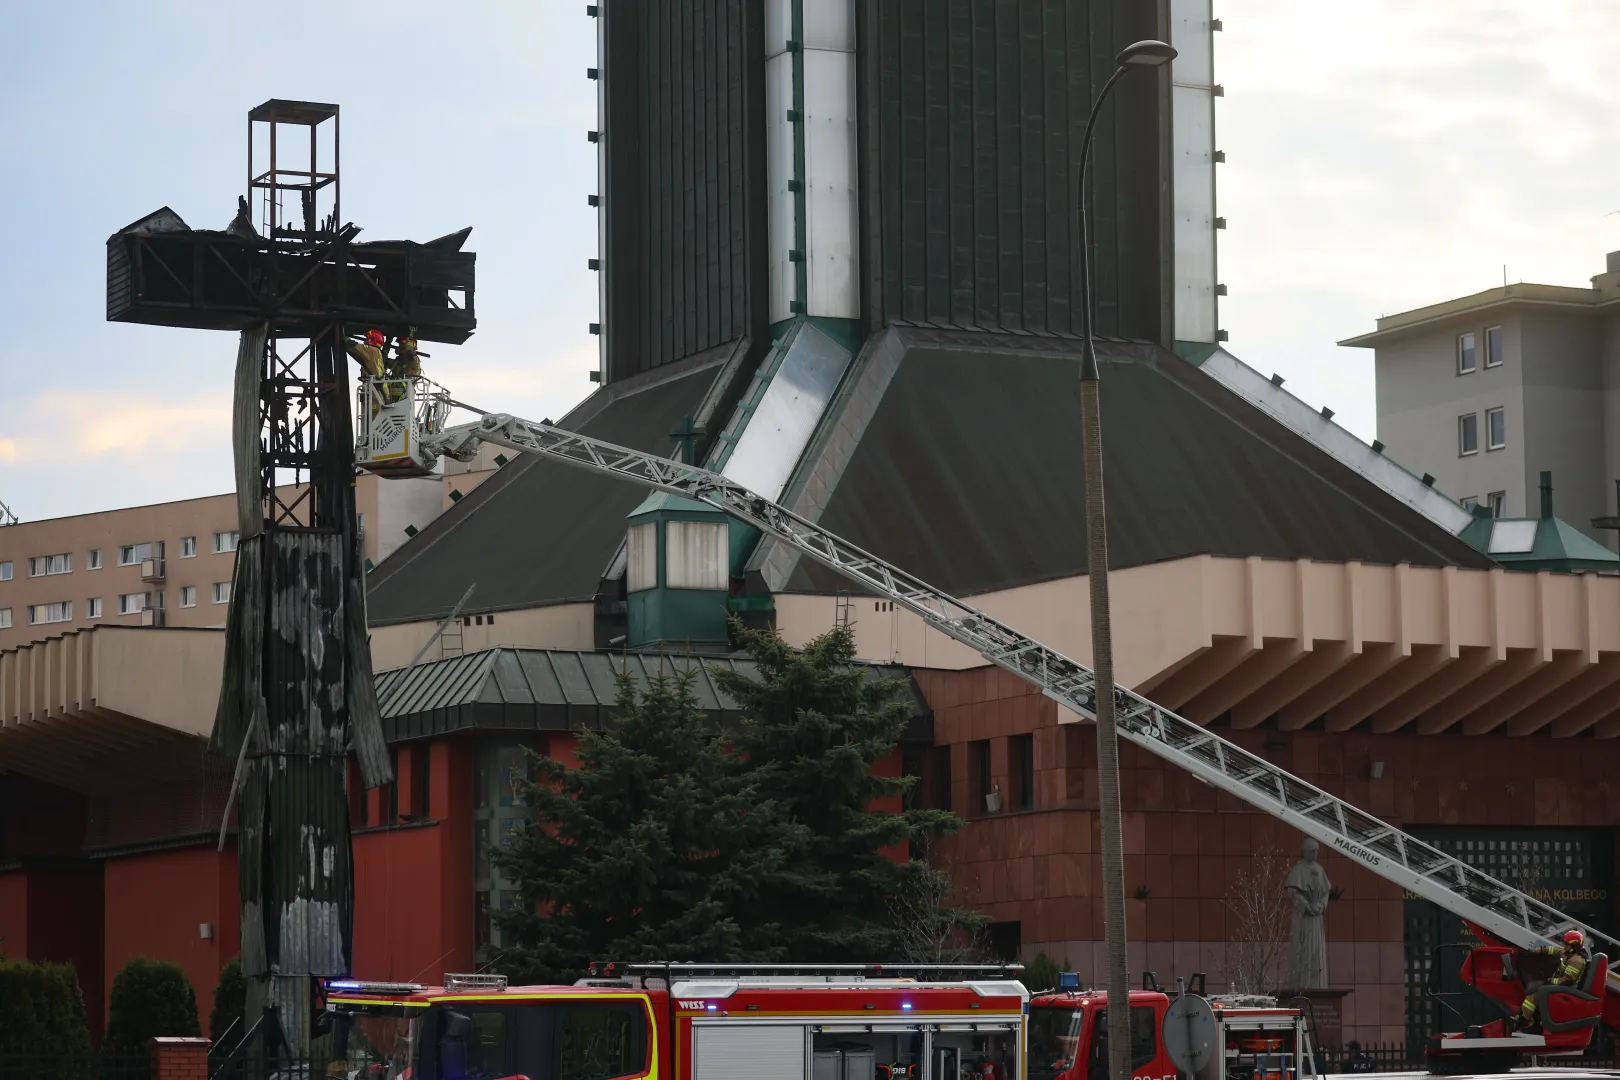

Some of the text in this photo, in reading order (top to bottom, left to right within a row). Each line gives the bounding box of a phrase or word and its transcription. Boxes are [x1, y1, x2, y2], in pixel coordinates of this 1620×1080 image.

[380, 425, 406, 451] MAGIRUS
[1333, 837, 1380, 866] MAGIRUS
[1553, 889, 1608, 900] KOLBEGO
